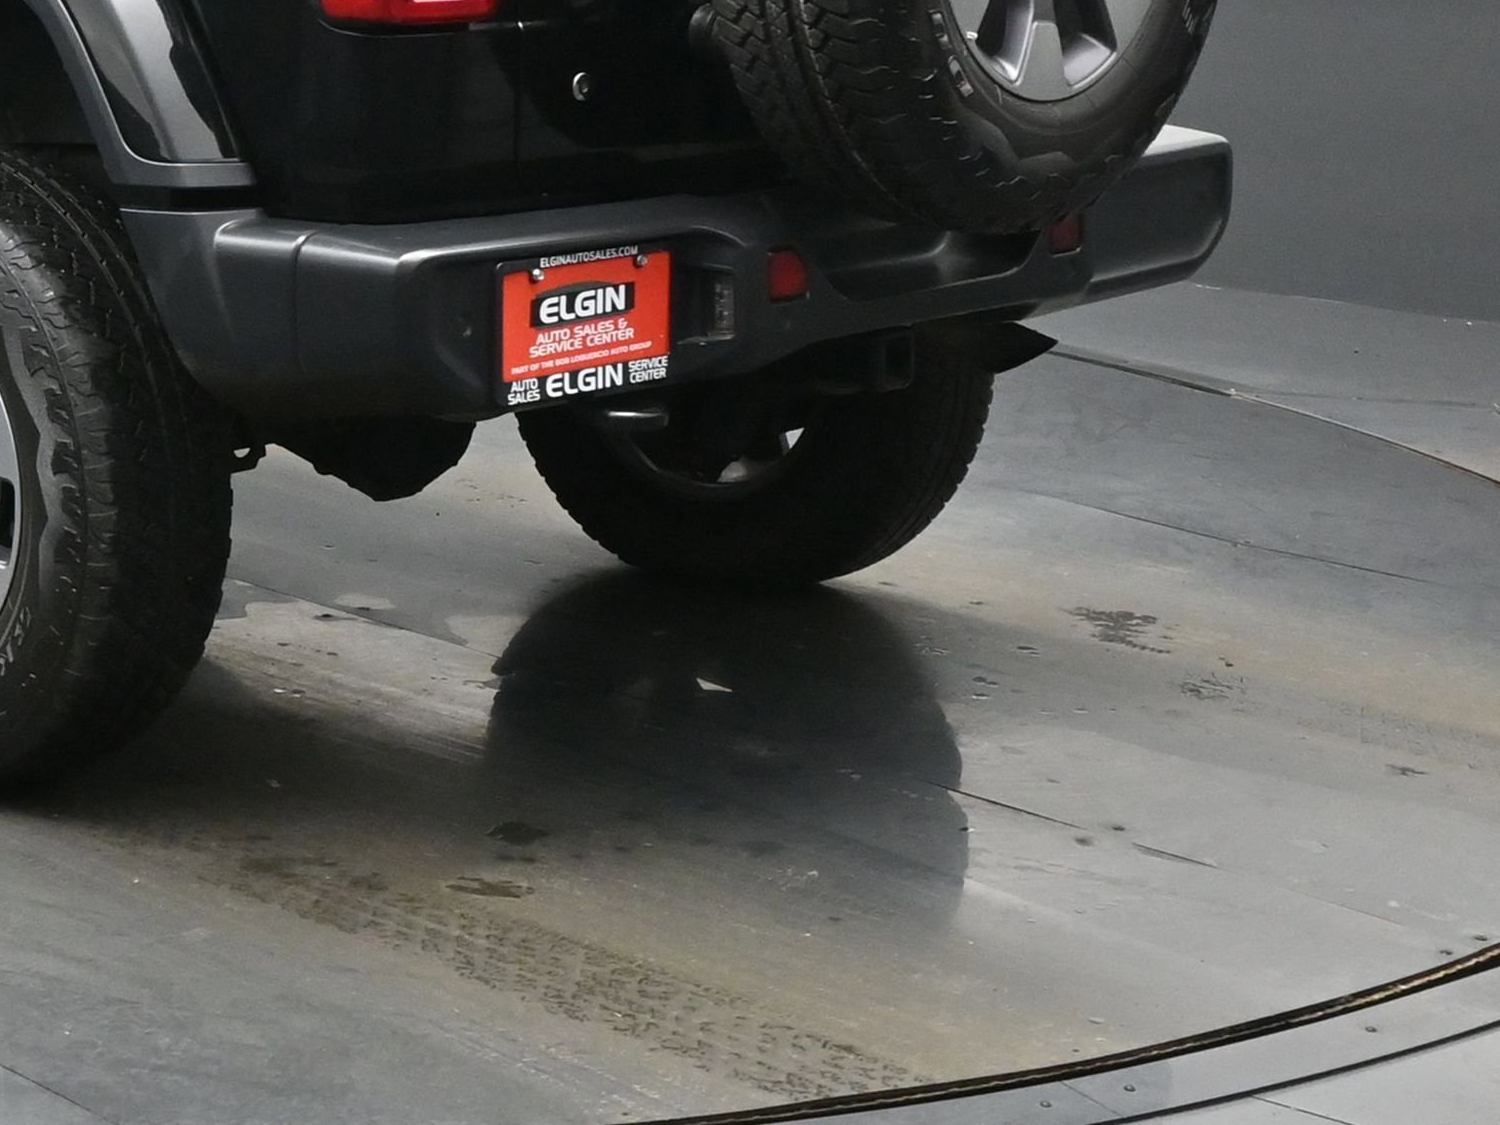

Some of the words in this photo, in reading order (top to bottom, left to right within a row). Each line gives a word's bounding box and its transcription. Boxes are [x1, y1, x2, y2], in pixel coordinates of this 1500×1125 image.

[540, 246, 638, 268] ELGINAUTOSALES.COM
[539, 284, 626, 324] ELGIN
[529, 338, 583, 358] SERVICE
[586, 328, 634, 347] CENTER
[536, 328, 570, 345] AUTO
[574, 320, 615, 338] SALES
[618, 318, 628, 329] &
[511, 365, 529, 375] PART
[530, 363, 539, 371] OF
[540, 360, 554, 368] THE
[610, 345, 629, 355] AUTO
[629, 341, 652, 351] GROUP
[628, 355, 669, 373] SERVICE
[510, 378, 539, 393] AUTO
[546, 363, 623, 398] ELGIN
[629, 367, 667, 384] CENTER
[508, 389, 541, 406] SALES
